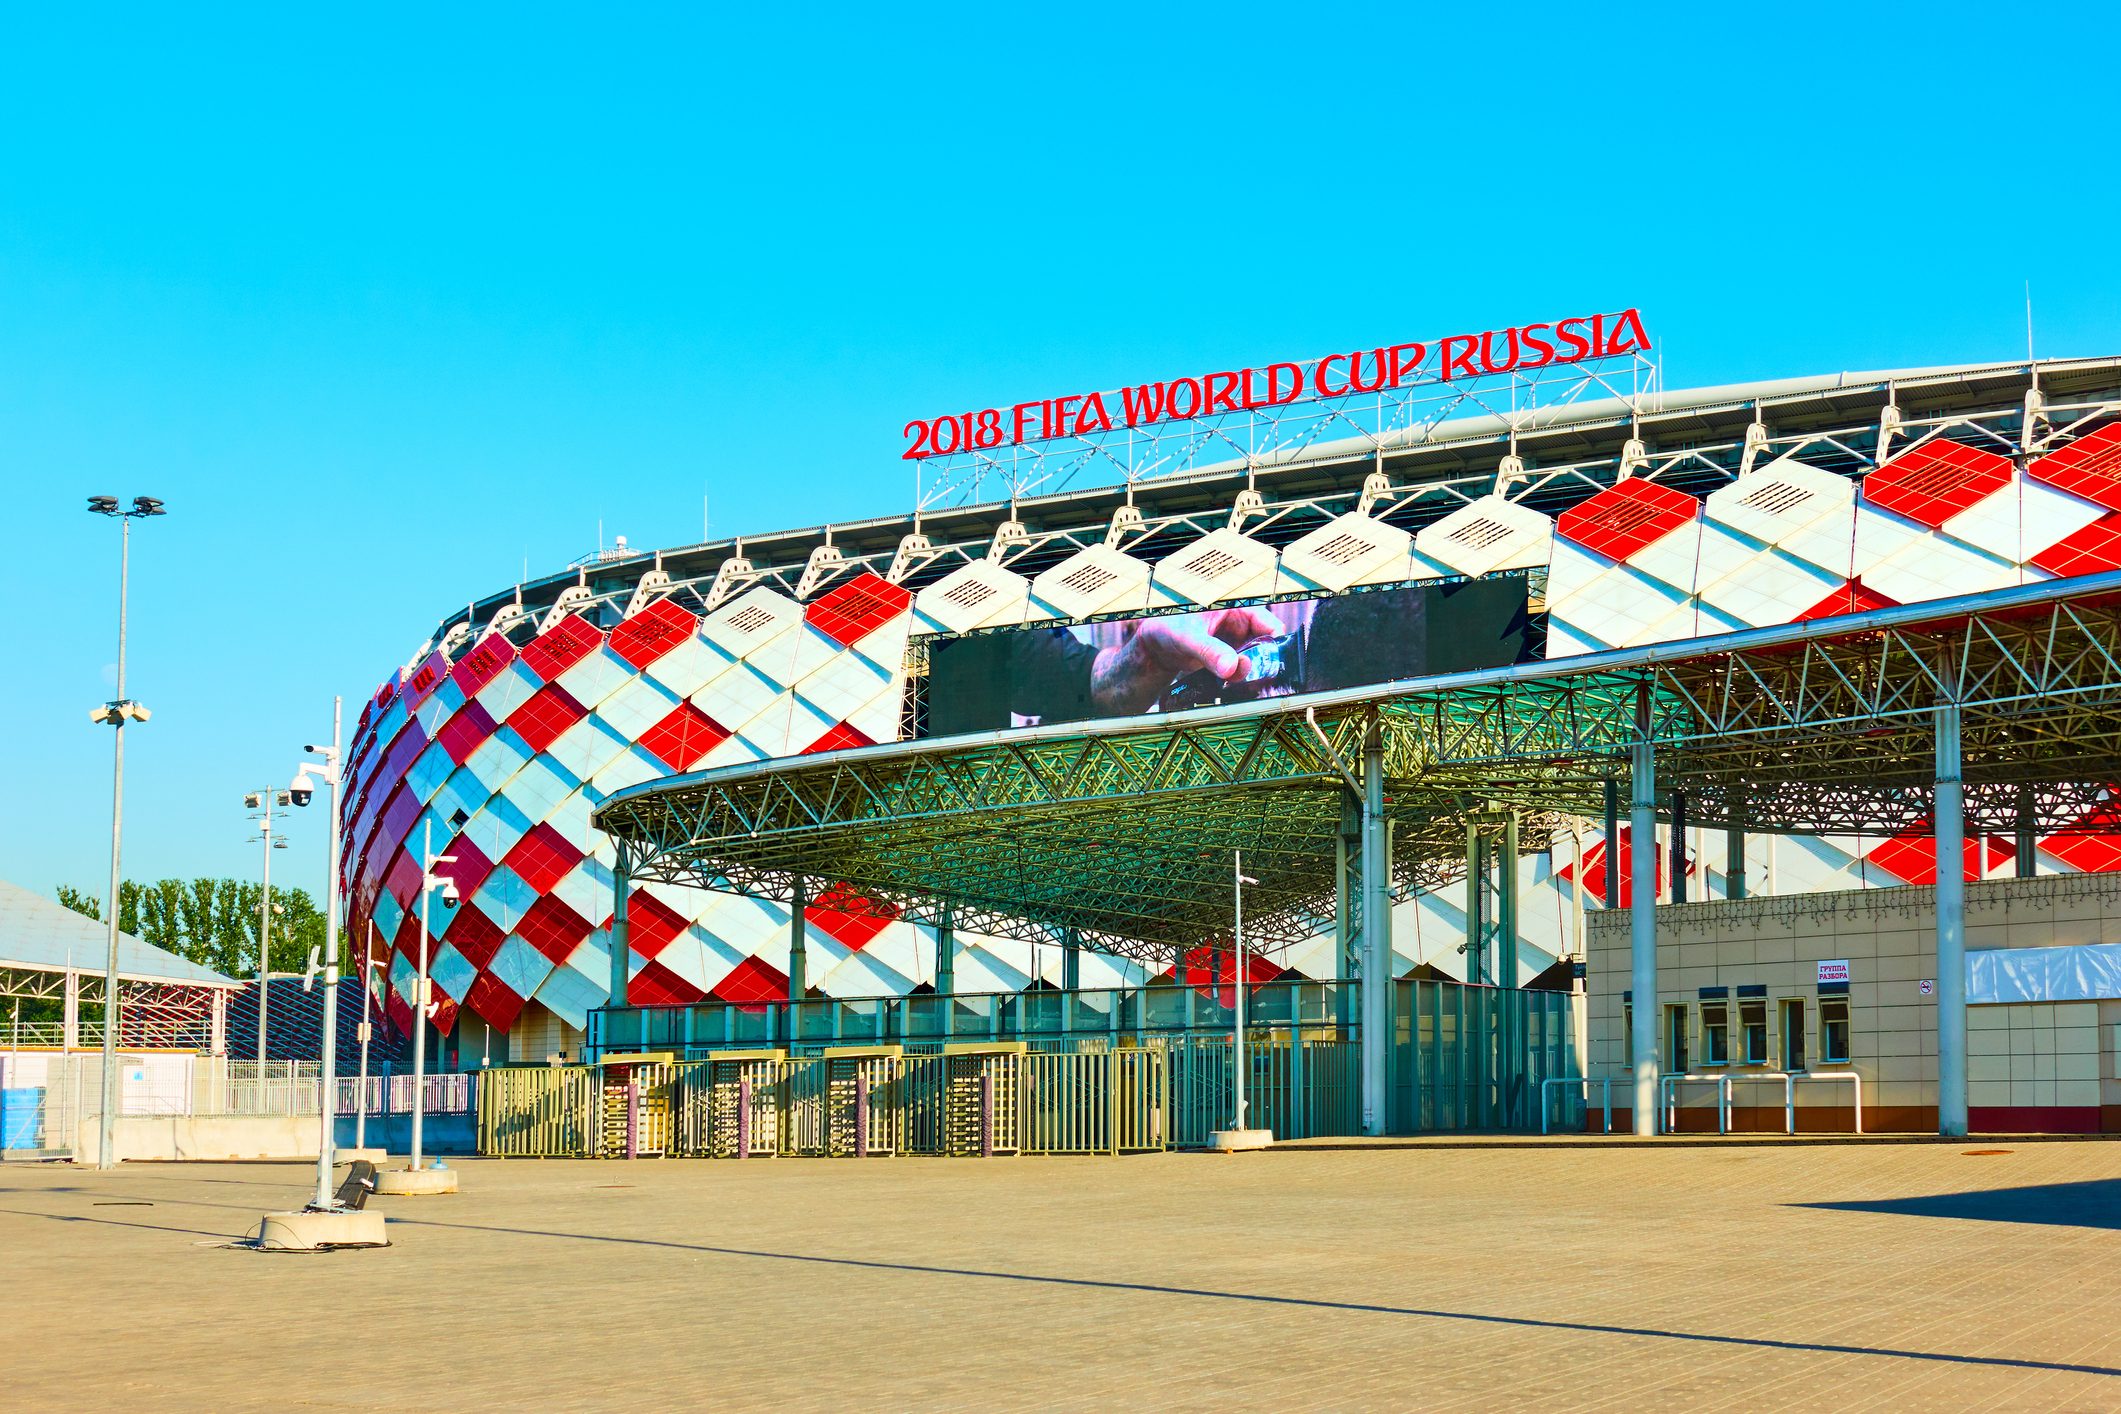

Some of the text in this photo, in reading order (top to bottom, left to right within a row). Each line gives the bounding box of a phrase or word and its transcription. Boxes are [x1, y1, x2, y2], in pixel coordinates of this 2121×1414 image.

[902, 308, 1652, 460] 2018 FIFA WORLD CUP RUSSIA
